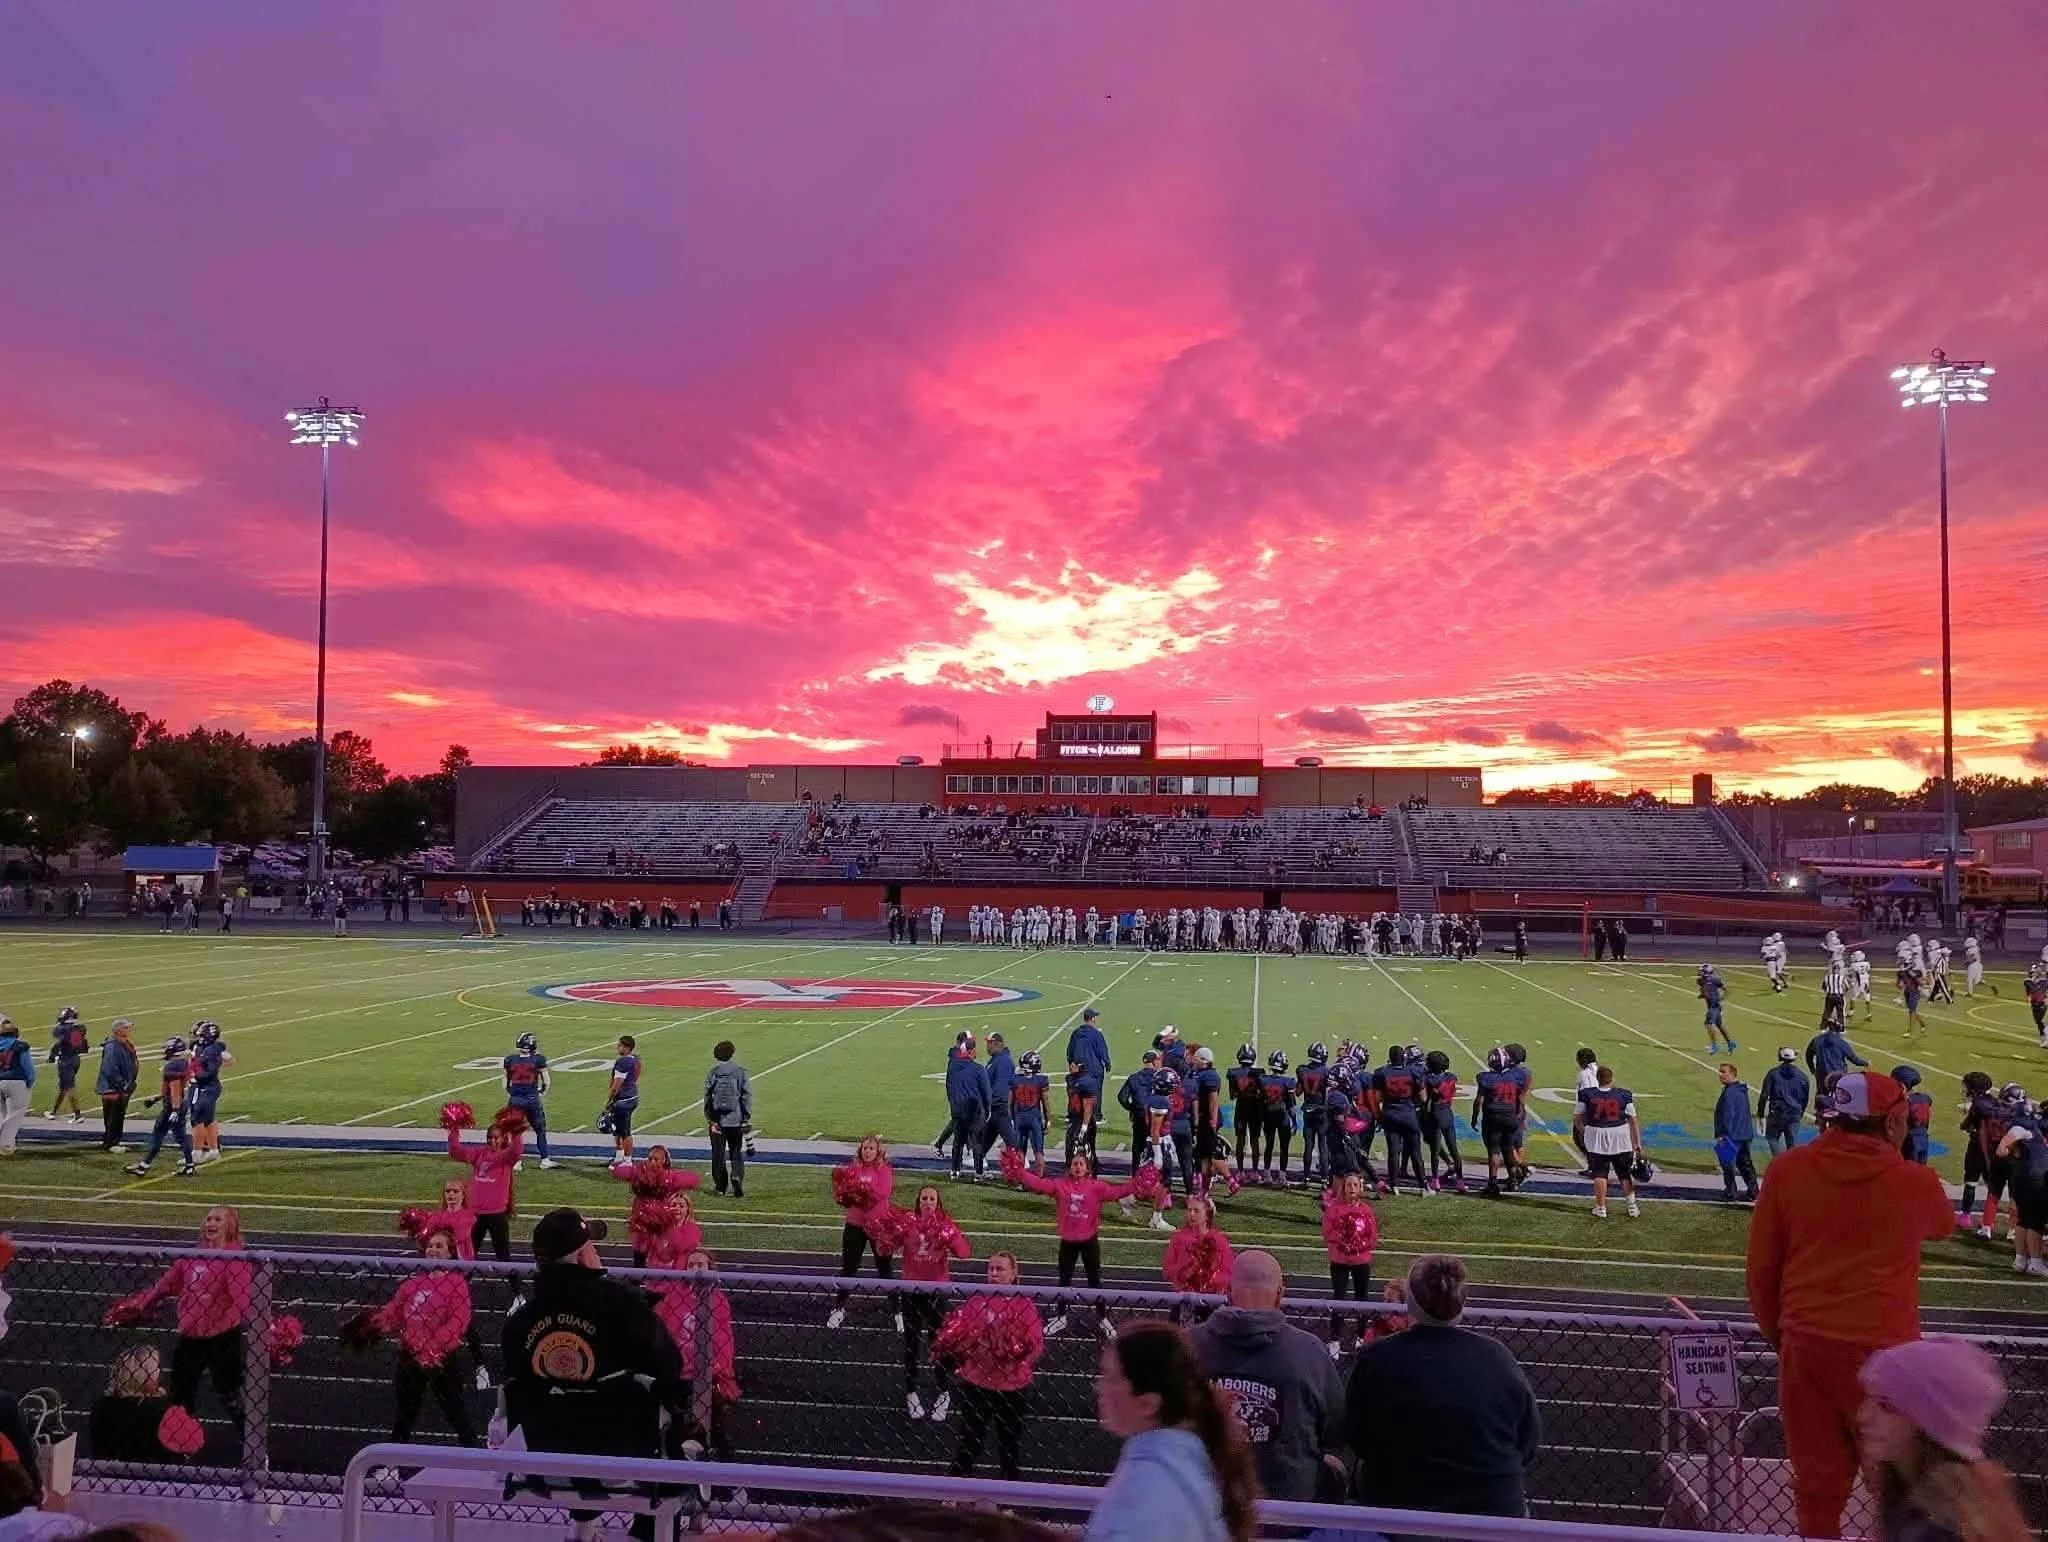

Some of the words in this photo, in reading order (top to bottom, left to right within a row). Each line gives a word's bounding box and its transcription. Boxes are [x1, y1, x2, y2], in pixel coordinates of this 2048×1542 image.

[1094, 696, 1106, 711] F
[1590, 1098, 1621, 1121] 78
[524, 1315, 553, 1350] HONOR
[557, 1313, 597, 1336] GUARD
[1678, 1343, 1728, 1359] HANDICAP
[1686, 1360, 1727, 1376] SEATING
